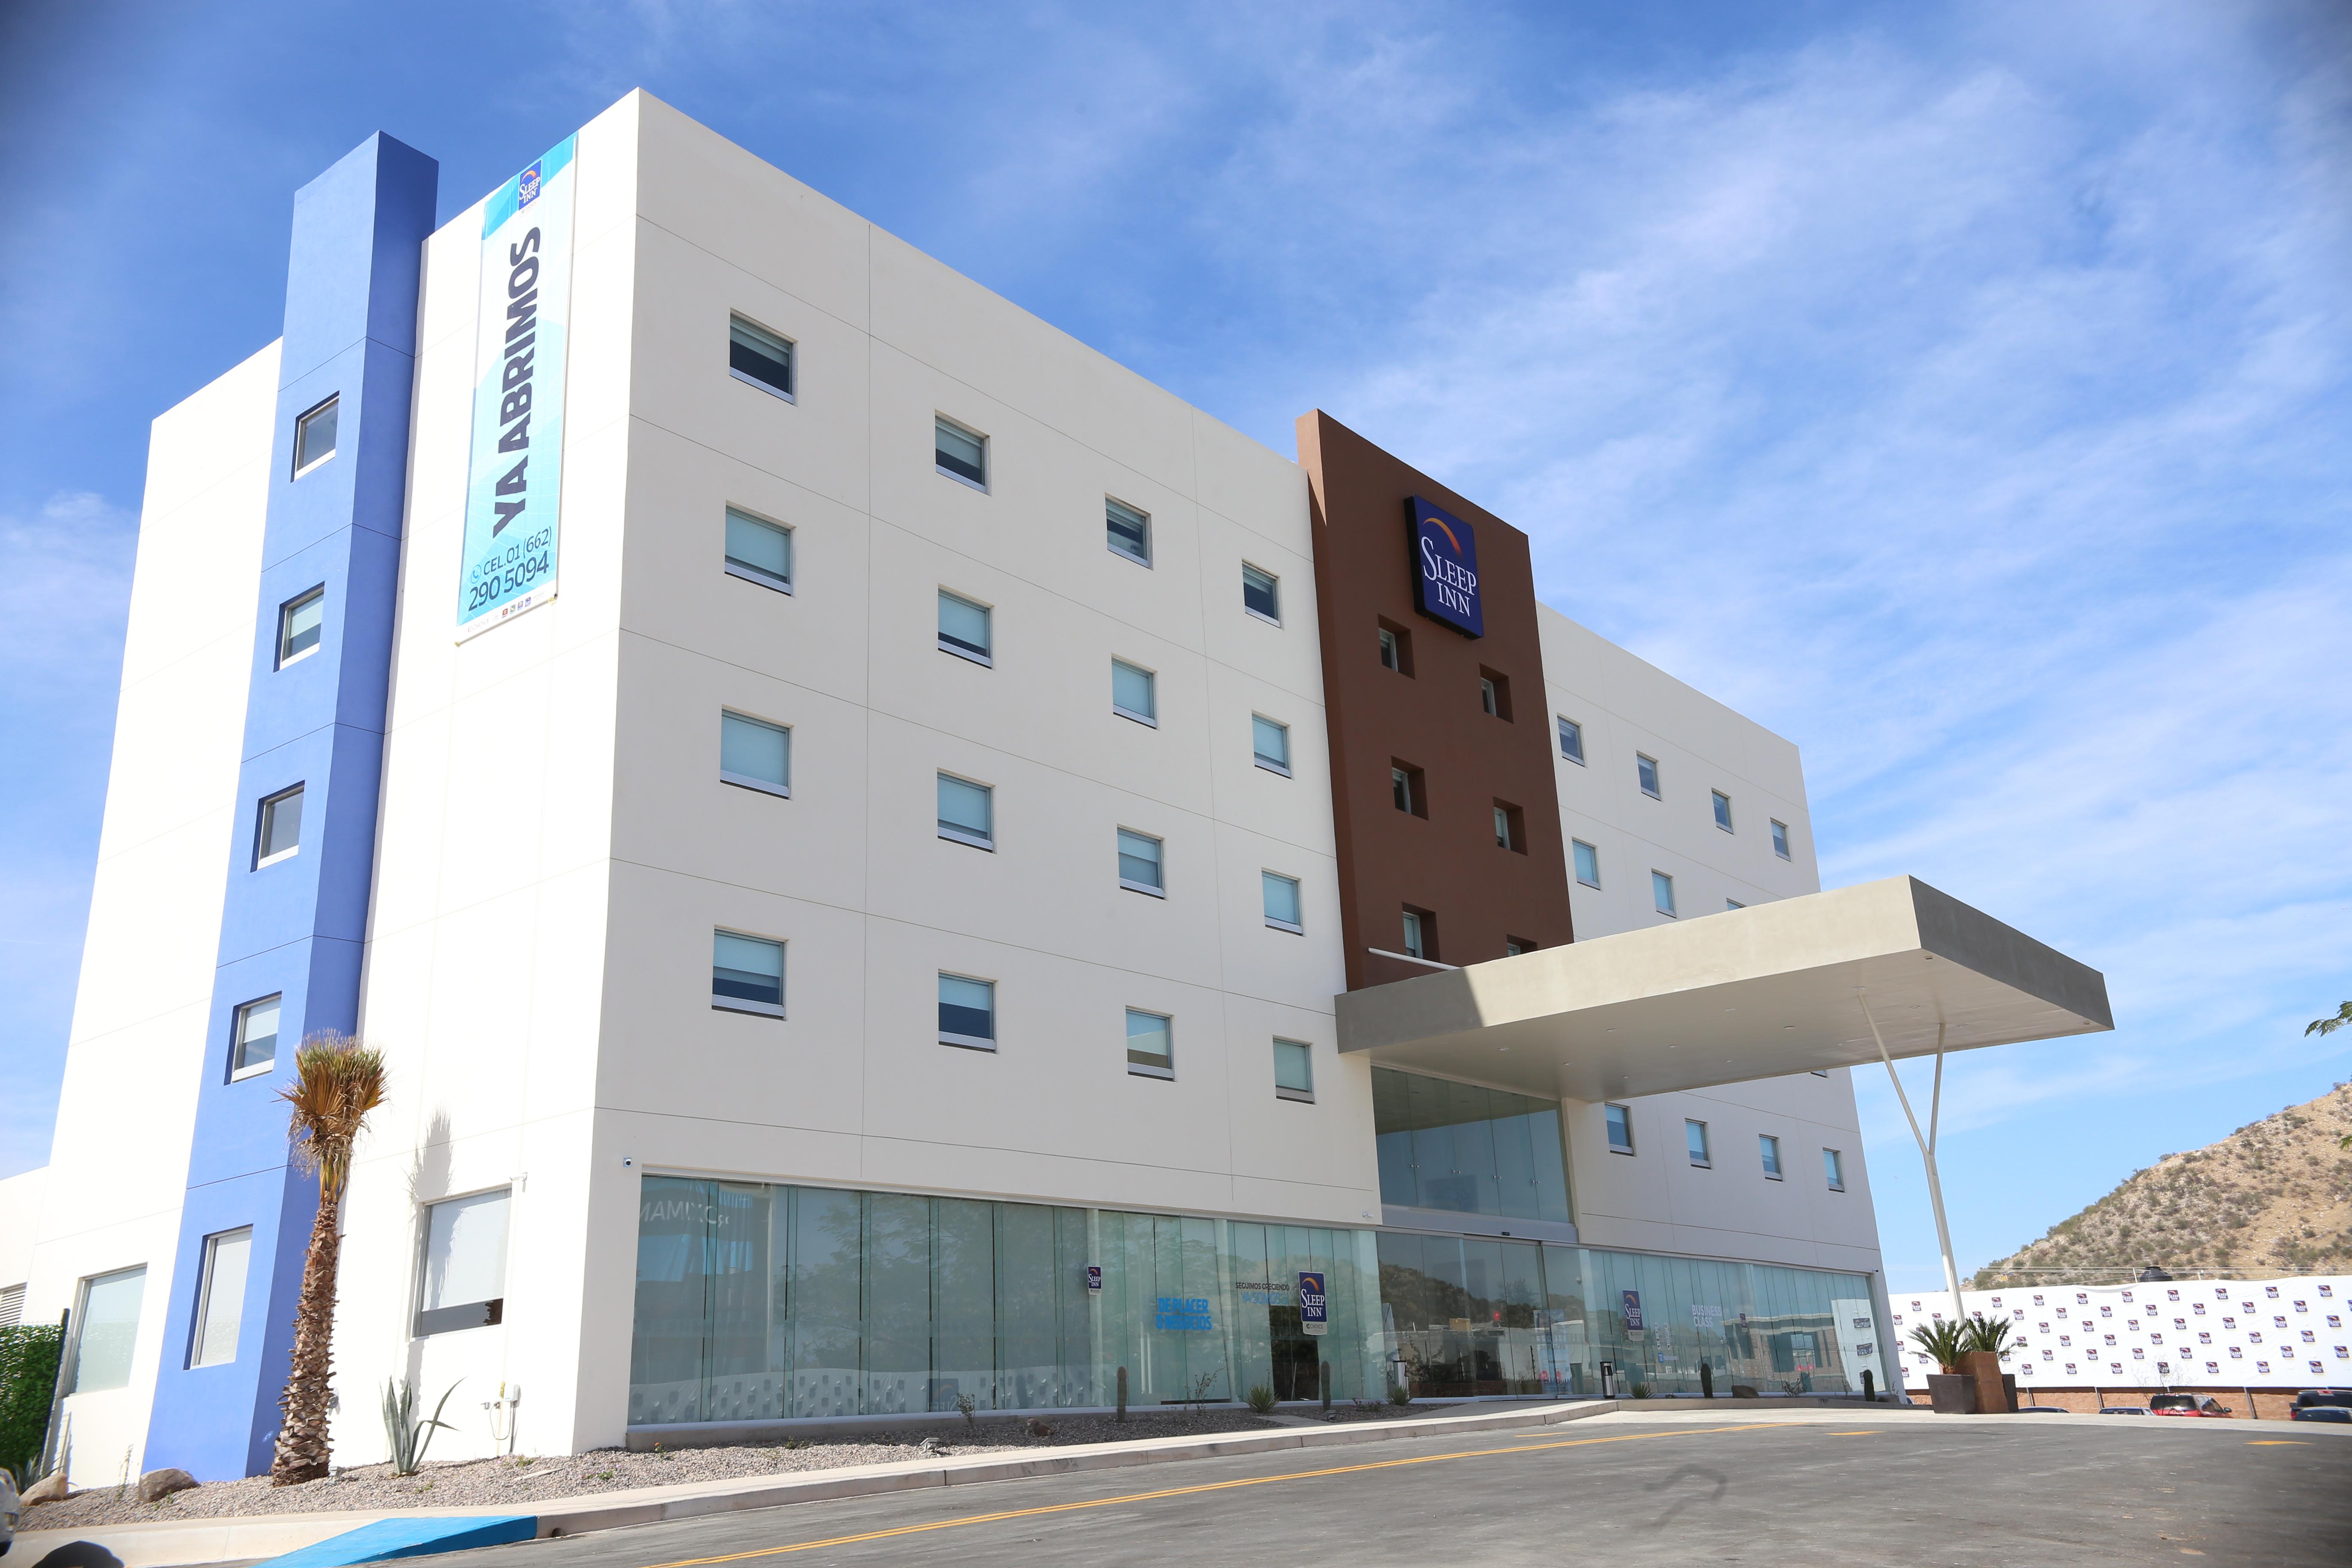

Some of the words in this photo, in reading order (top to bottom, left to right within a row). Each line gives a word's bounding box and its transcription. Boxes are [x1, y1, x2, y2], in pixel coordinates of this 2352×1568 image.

[519, 176, 540, 200] SLEEP
[523, 187, 538, 204] INN
[498, 226, 541, 454] ABRIMOS
[493, 454, 528, 539] YA
[523, 526, 551, 559] (662)
[1421, 536, 1476, 596] SLEEP
[469, 576, 500, 612] 290
[504, 550, 549, 593] 5094
[1436, 582, 1470, 617] INN
[1088, 1274, 1101, 1283] SLEEP
[1301, 1289, 1325, 1308] SLEEP
[1307, 1307, 1322, 1317] INN
[1625, 1304, 1641, 1319] SLEEP
[1692, 1305, 1722, 1316] BUSINESS
[1694, 1316, 1713, 1327] CLASS
